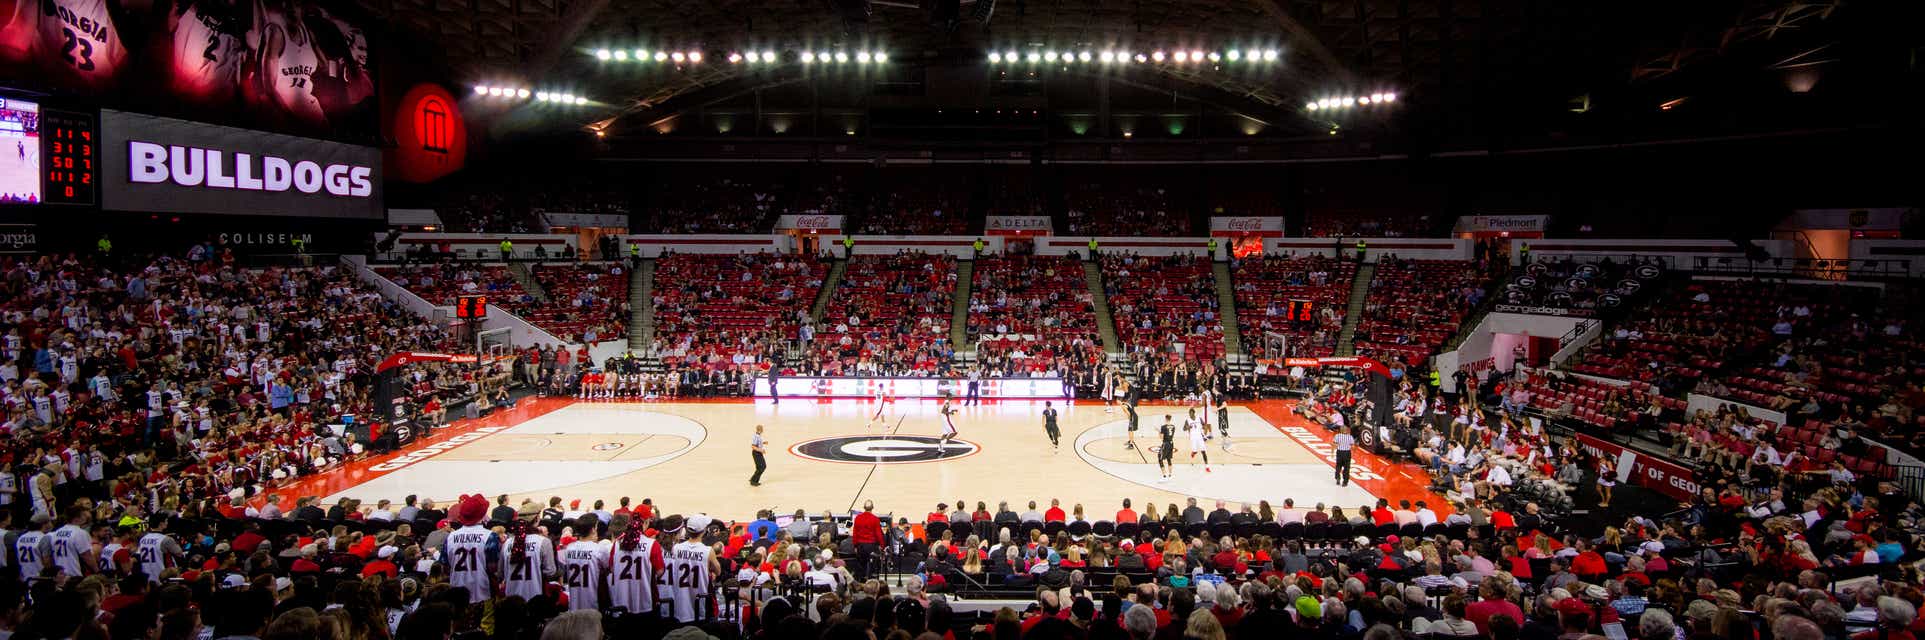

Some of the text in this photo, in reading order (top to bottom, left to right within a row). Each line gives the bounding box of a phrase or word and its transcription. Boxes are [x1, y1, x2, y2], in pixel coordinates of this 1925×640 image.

[58, 5, 107, 43] ORGIA
[62, 27, 95, 71] 23
[54, 141, 62, 153] 3
[83, 144, 90, 156] 3
[53, 156, 62, 168] 5
[129, 140, 372, 197] BULLDOGS
[82, 173, 91, 183] 2
[1004, 219, 1046, 227] DELTA
[1489, 219, 1537, 228] Piedmont
[368, 426, 507, 471] GEORGIA
[1648, 467, 1664, 480] OF
[454, 533, 483, 544] WILKINS
[20, 546, 34, 562] 21
[141, 547, 156, 562] 21
[455, 547, 477, 571] 21
[568, 550, 592, 560] WILKINS
[677, 550, 703, 561] WILKINS
[620, 555, 642, 580] 21
[569, 564, 589, 588] 21
[679, 563, 699, 588] 21
